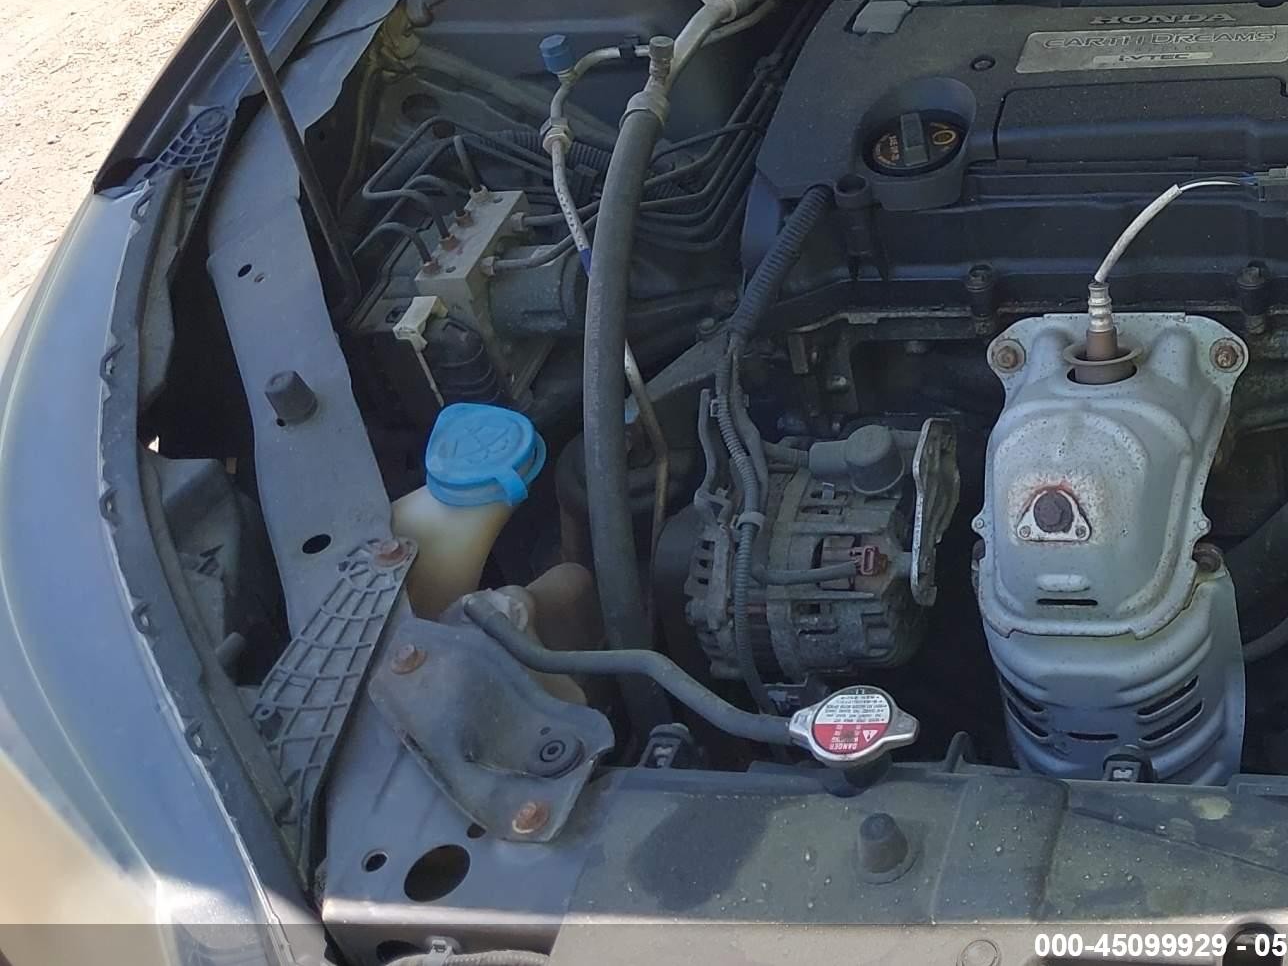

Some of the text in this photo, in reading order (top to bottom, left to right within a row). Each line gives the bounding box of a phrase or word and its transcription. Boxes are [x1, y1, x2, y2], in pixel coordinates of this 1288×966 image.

[1089, 13, 1237, 26] HONDA
[1044, 35, 1146, 49] EARTH
[1151, 31, 1275, 45] DREAMS
[1119, 53, 1190, 62] i-VTEC
